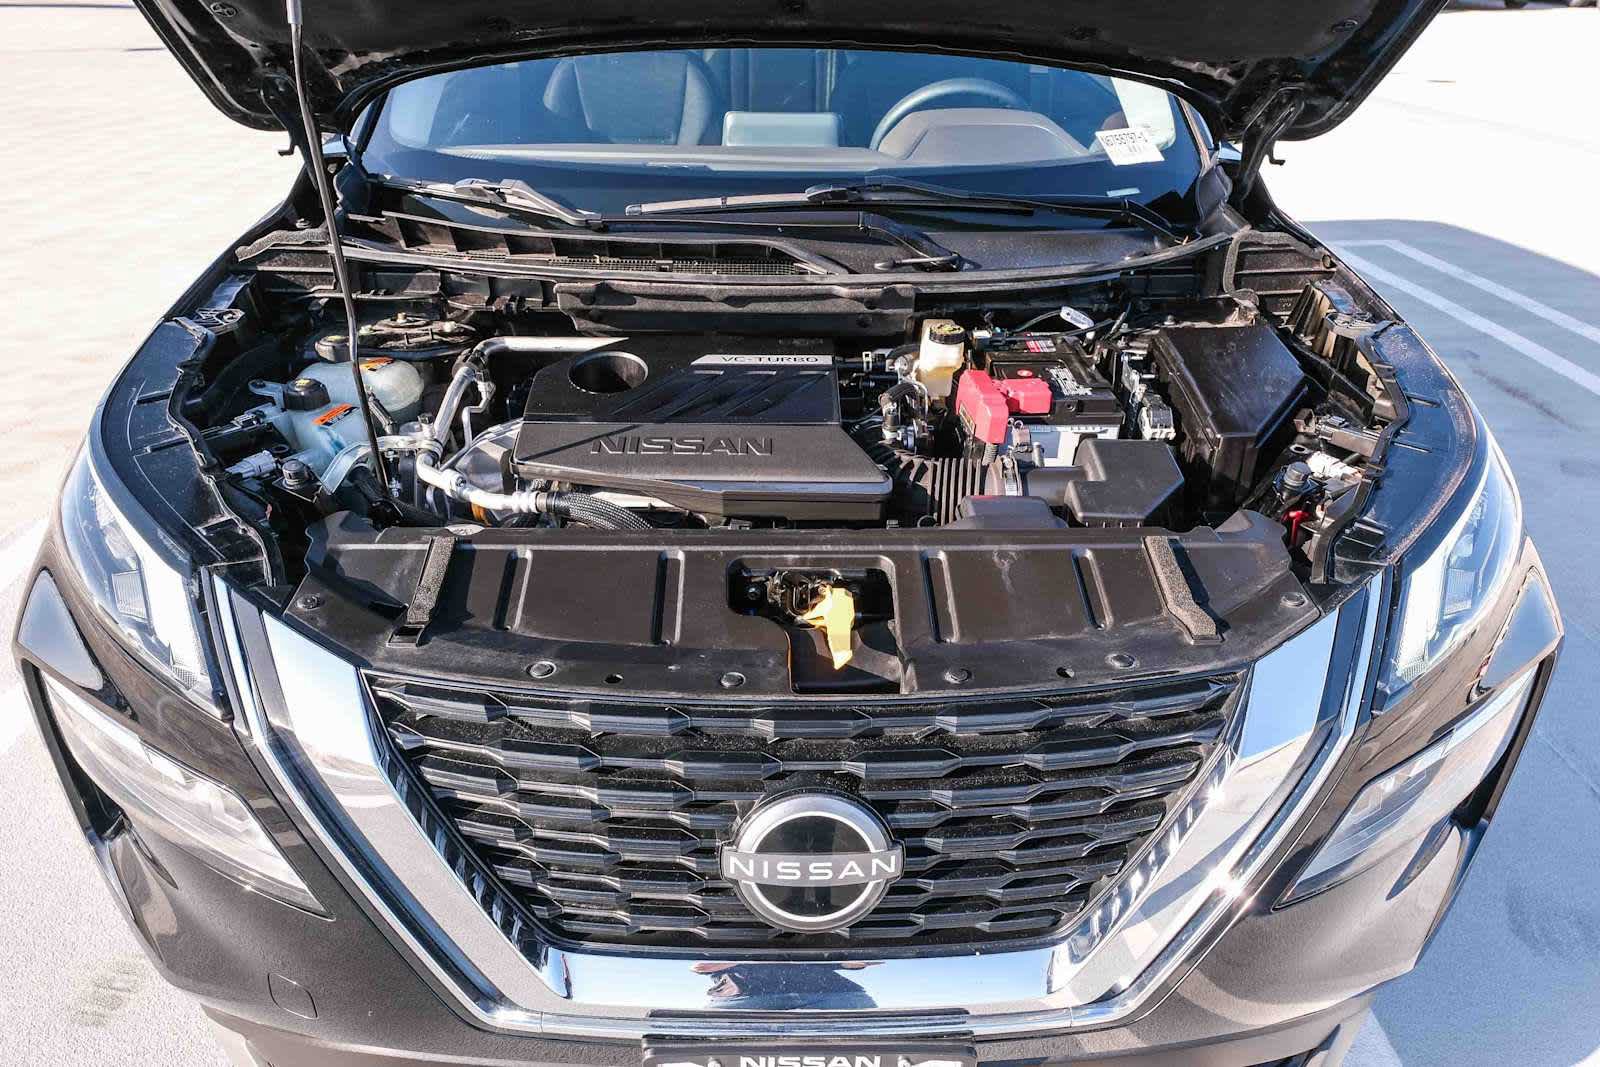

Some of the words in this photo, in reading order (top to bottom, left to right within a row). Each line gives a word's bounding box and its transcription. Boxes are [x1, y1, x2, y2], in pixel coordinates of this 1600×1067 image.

[590, 436, 773, 456] NISSAN
[729, 855, 896, 880] NISSAN
[740, 1056, 881, 1067] NISSAN
